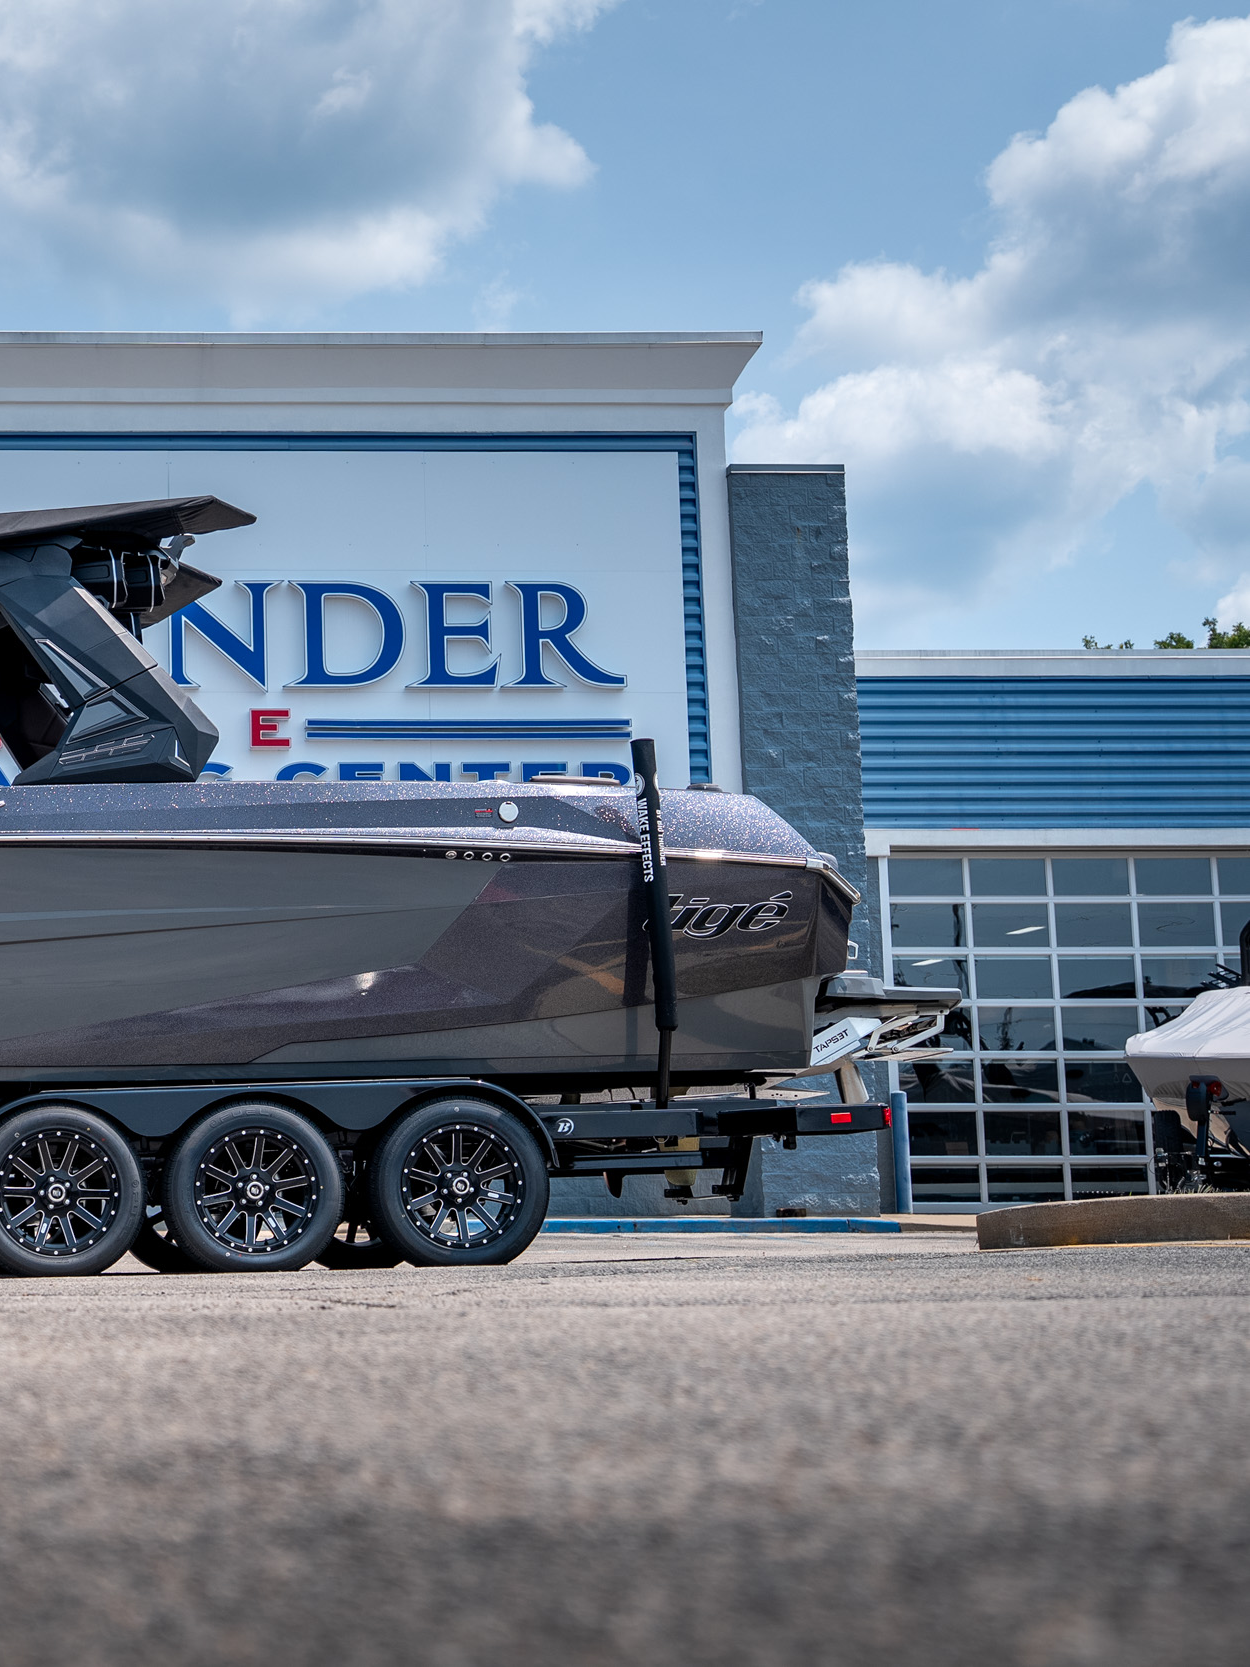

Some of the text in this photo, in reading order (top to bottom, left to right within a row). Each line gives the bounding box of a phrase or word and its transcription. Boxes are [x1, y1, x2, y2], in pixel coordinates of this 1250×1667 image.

[637, 798, 655, 882] WAKE EFFECTS
[658, 832, 667, 867] THUNDER
